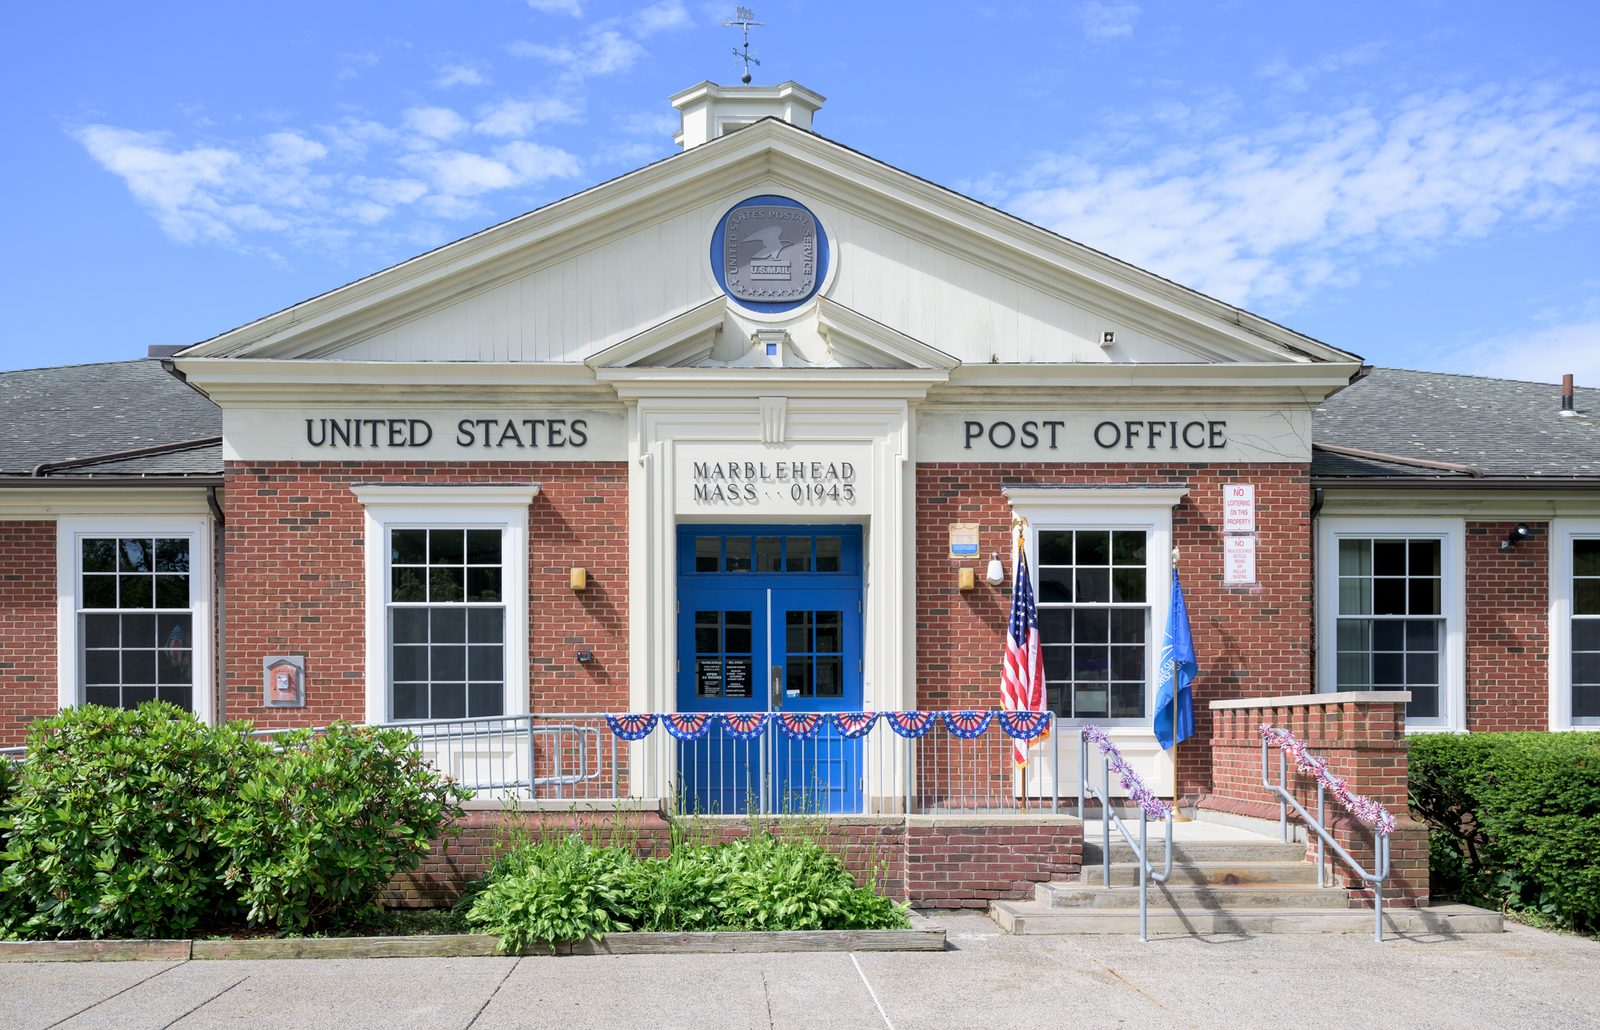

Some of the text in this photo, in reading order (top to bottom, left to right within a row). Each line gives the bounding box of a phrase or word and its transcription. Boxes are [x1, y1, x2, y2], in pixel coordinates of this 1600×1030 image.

[729, 210, 812, 275] UNITED STATES POSTAL SERVICE
[305, 418, 588, 448] UNITED STATES
[964, 420, 1227, 449] POST OFFICE
[693, 461, 854, 480] MARBLEHEAD
[790, 483, 854, 501] 01945
[1233, 488, 1245, 497] NO
